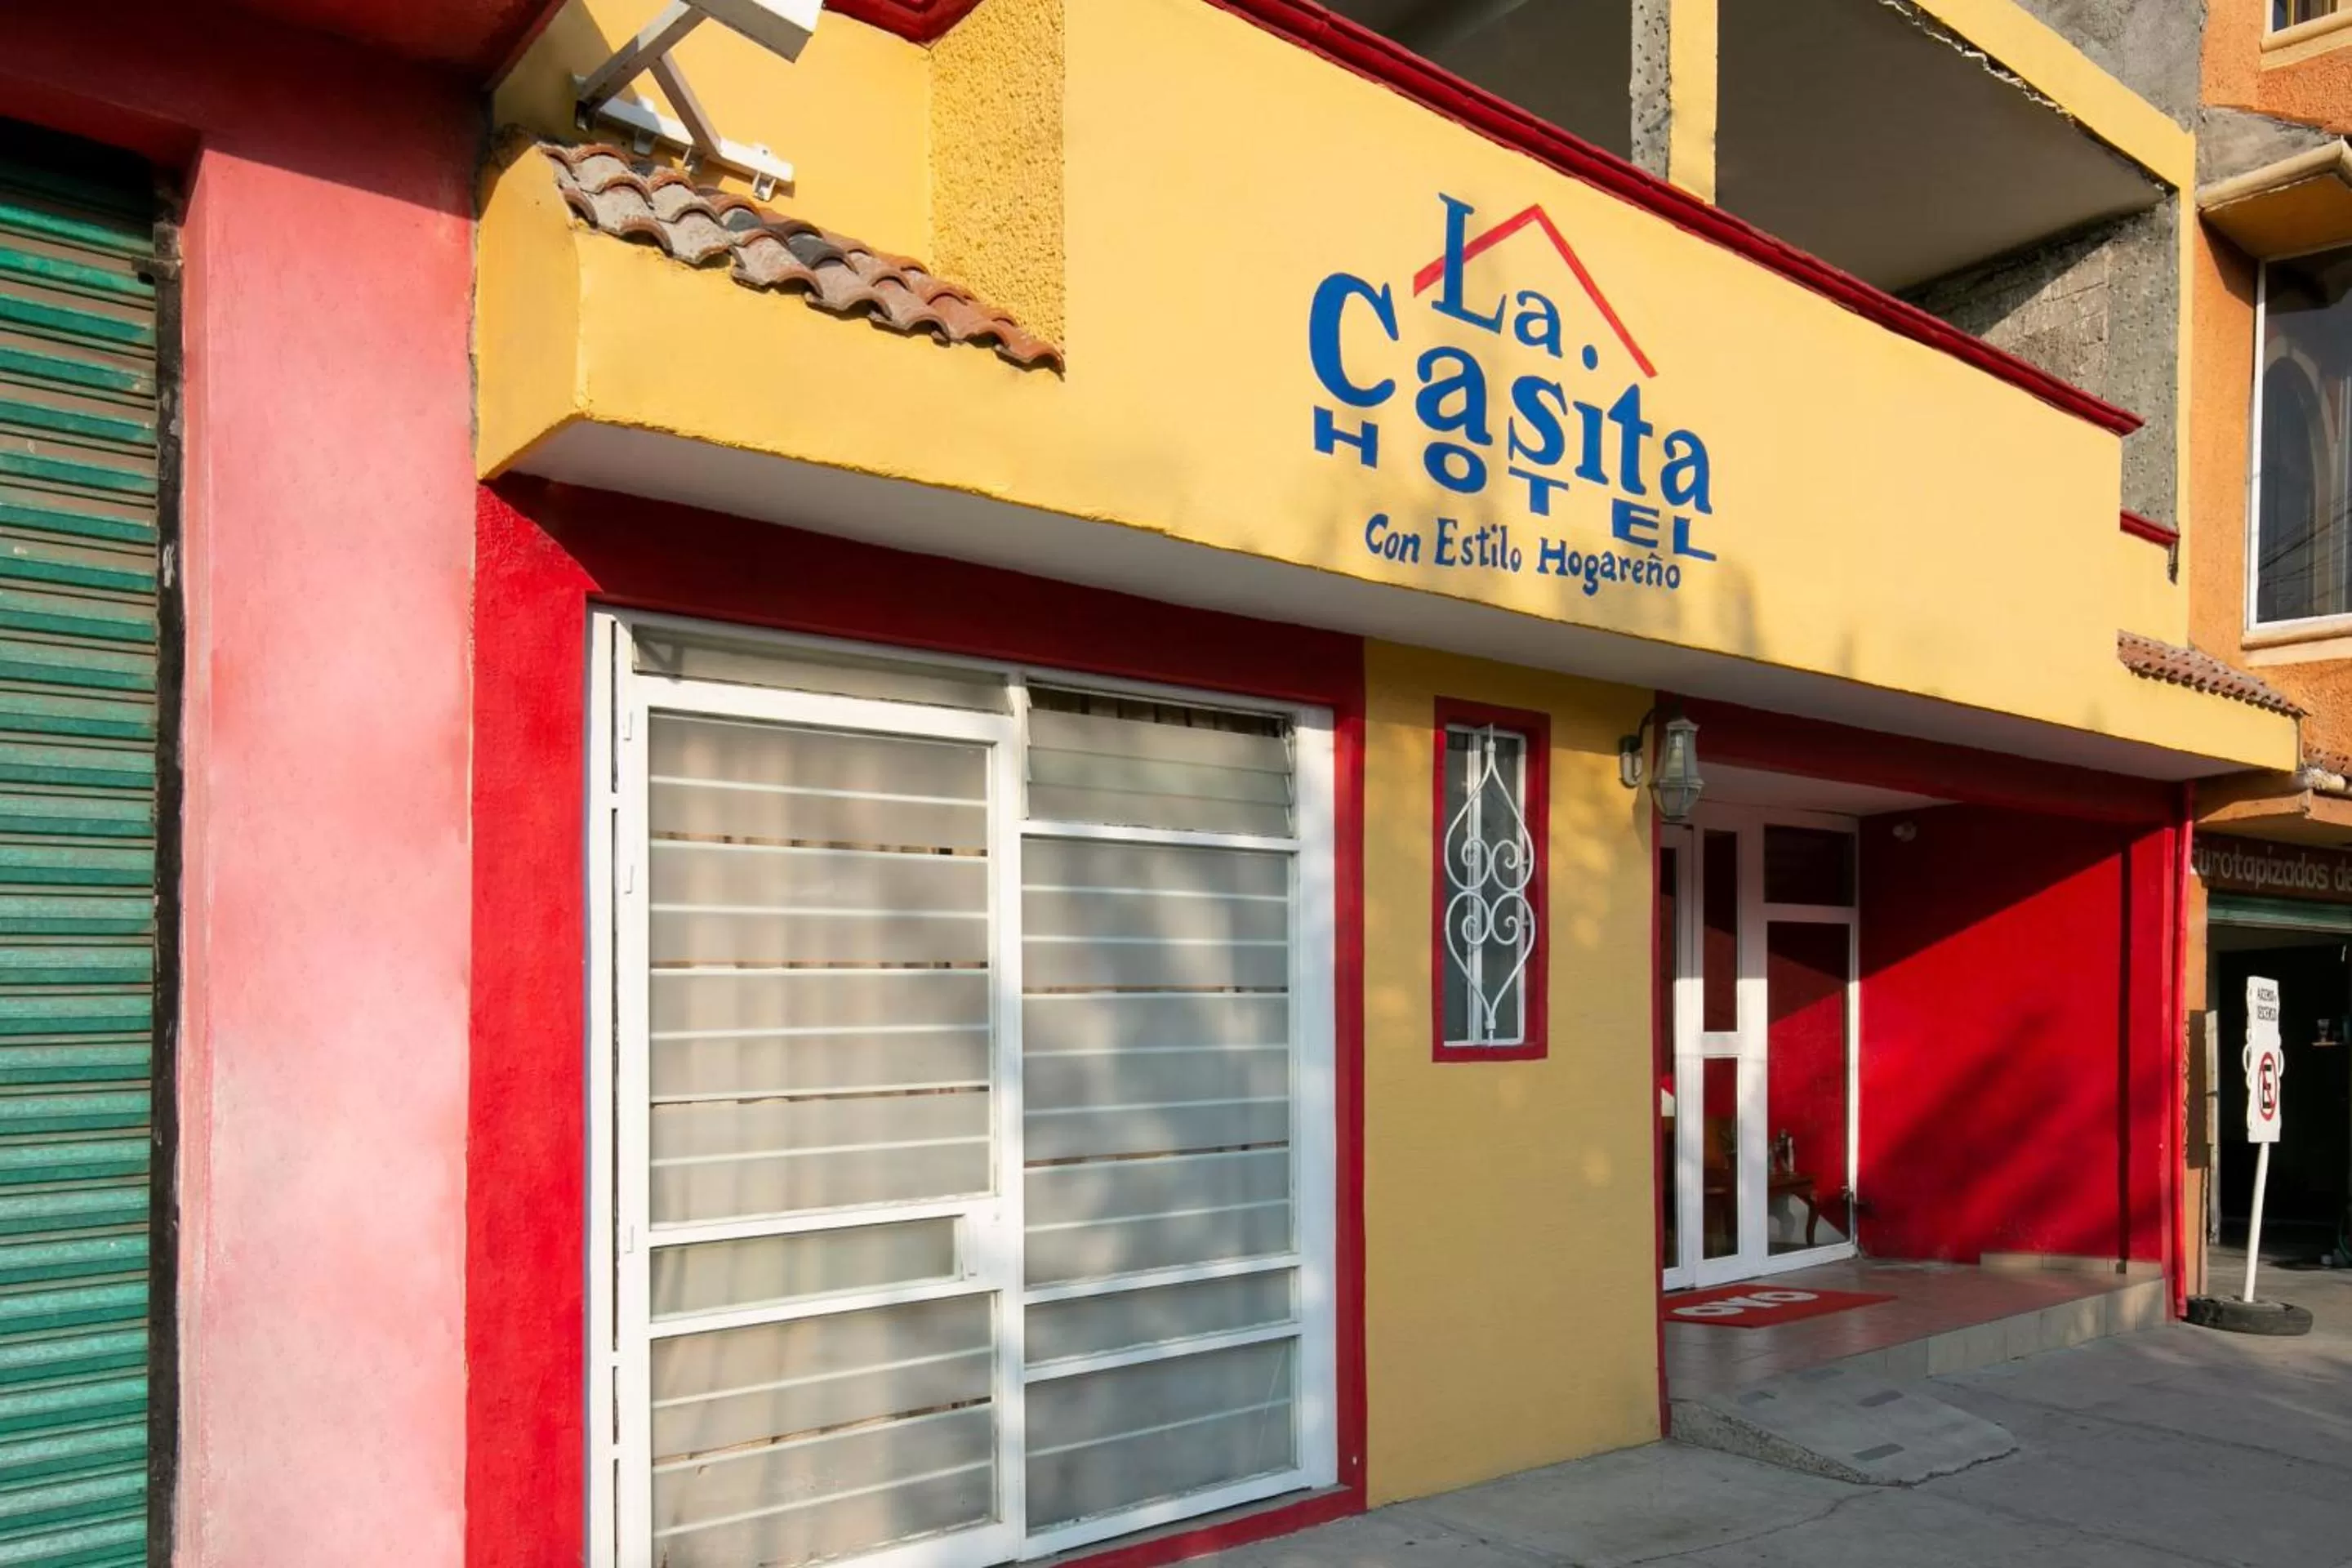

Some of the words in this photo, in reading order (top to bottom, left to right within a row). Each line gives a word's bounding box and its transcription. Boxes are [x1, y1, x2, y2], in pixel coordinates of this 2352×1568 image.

[1432, 192, 1562, 358] La
[1309, 273, 1713, 514] Casita
[1314, 405, 1717, 562] HOTEL
[1365, 514, 1421, 564] Con
[1435, 517, 1522, 572] Estilo
[1537, 537, 1682, 597] Hogareño
[2193, 840, 2328, 890] urotapizados
